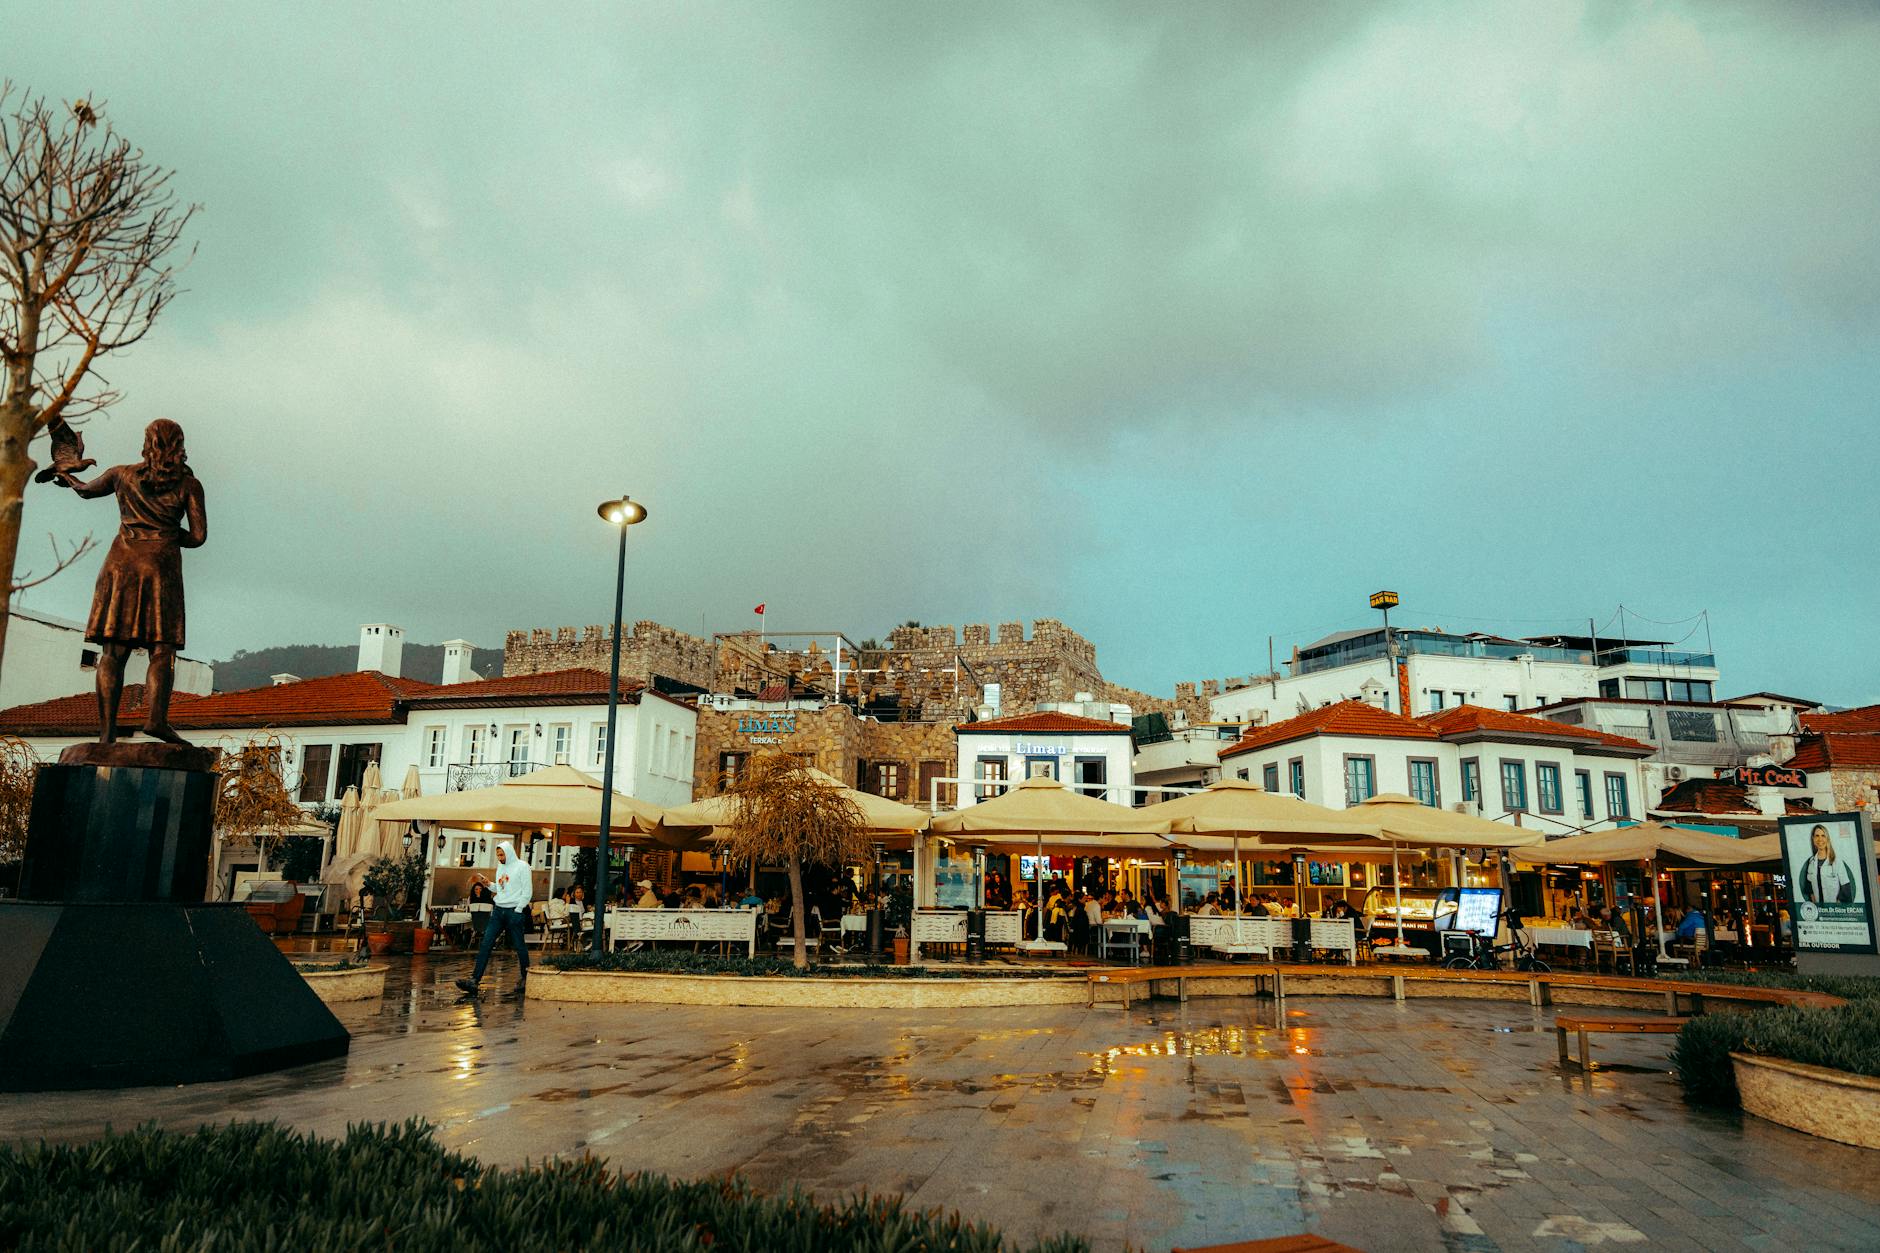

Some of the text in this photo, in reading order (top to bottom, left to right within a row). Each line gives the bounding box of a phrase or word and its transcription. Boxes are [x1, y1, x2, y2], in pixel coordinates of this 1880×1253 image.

[750, 736, 783, 744] TERRACE
[1016, 742, 1068, 755] Liman
[1739, 767, 1763, 785] Mr.
[1764, 769, 1804, 788] Cook
